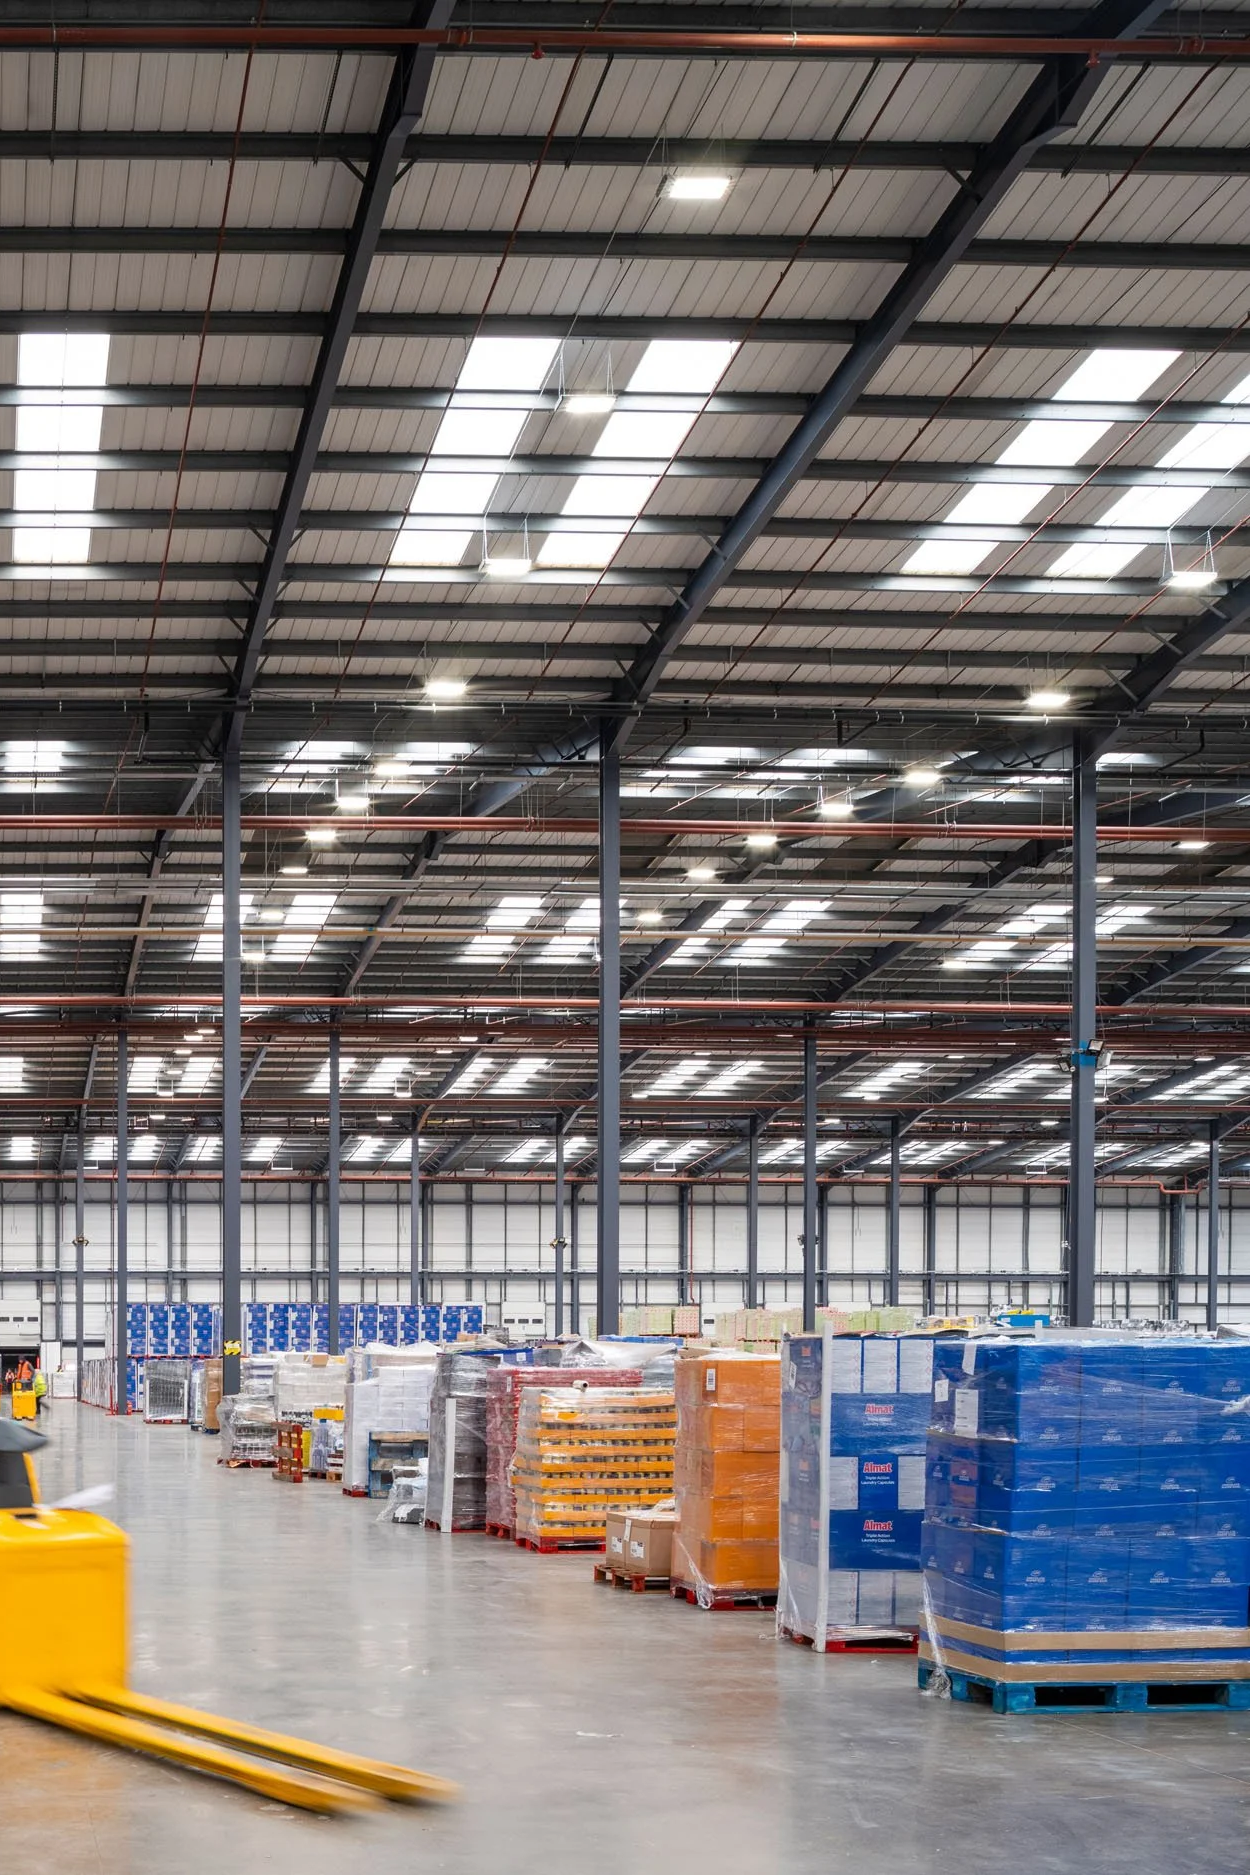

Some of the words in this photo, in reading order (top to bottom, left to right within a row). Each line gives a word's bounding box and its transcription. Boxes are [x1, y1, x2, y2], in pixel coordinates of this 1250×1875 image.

[864, 1403, 894, 1414] Almat
[863, 1462, 892, 1473] Almat
[863, 1520, 893, 1531] Almat
